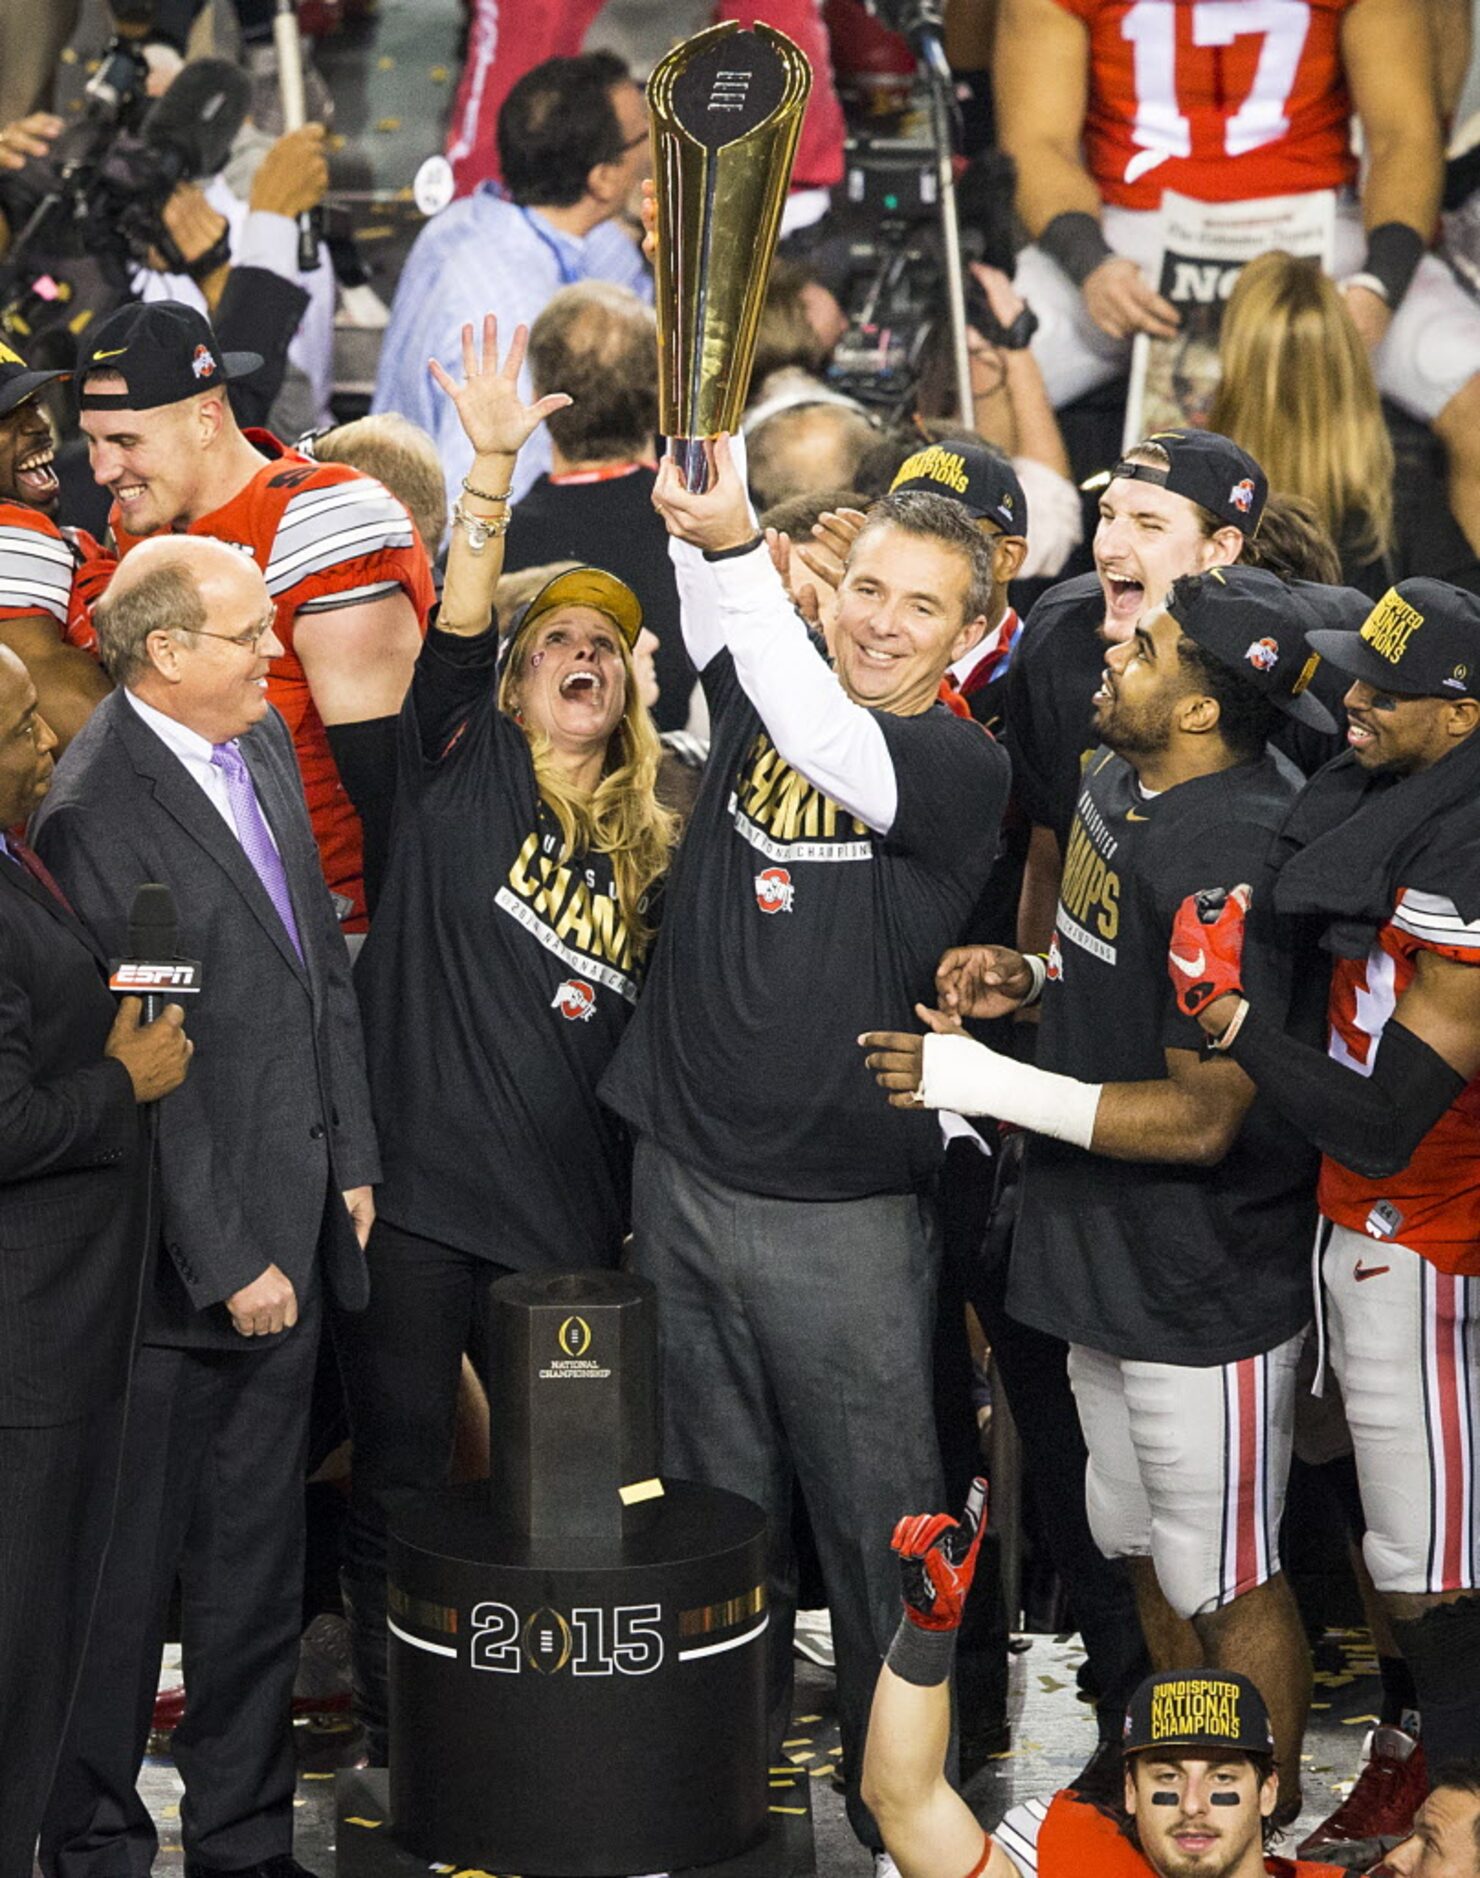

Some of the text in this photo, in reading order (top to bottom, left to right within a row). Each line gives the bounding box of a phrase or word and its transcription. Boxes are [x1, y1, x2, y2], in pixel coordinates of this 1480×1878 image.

[1121, 1, 1311, 158] 17
[116, 964, 194, 985] ESPN
[538, 1369, 612, 1379] CHAMPIONSHIP
[551, 1361, 600, 1369] NATIONAL
[1152, 1693, 1239, 1722] NATIONAL
[1152, 1715, 1240, 1740] CHAMPIONS
